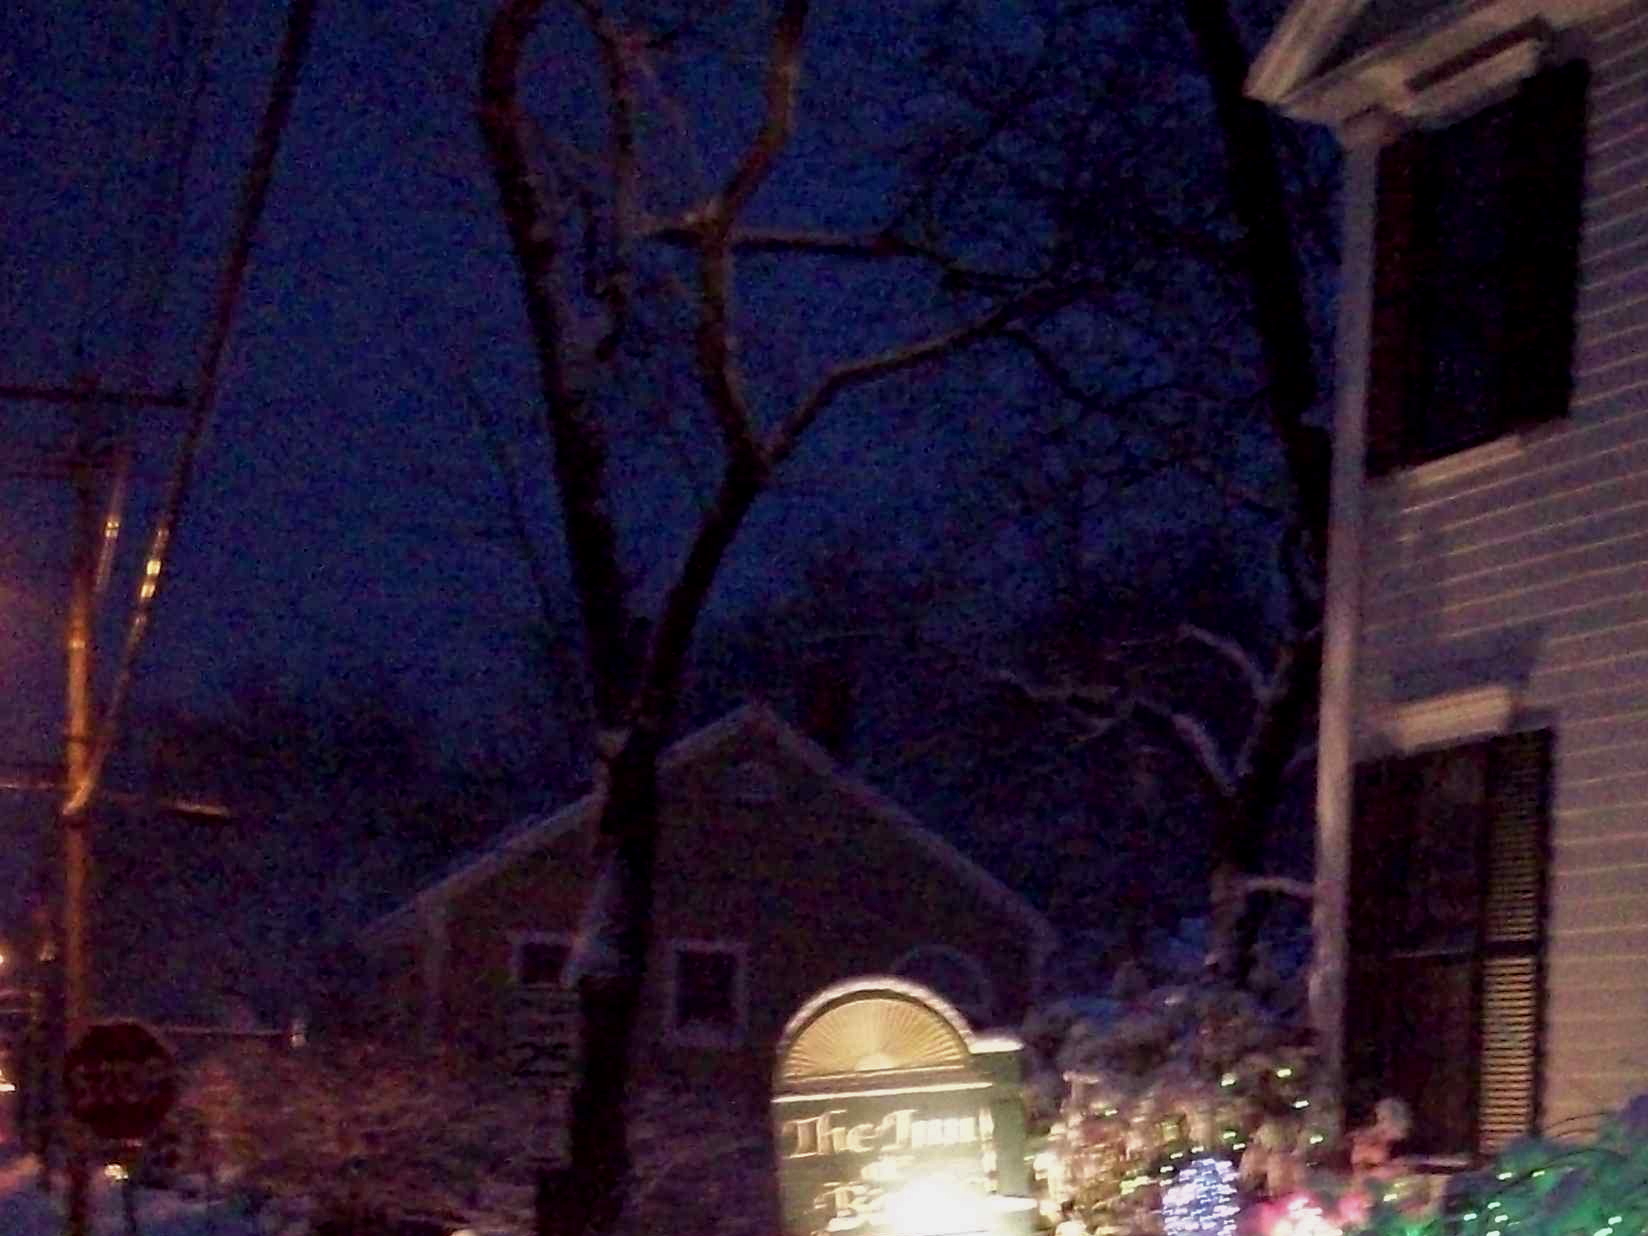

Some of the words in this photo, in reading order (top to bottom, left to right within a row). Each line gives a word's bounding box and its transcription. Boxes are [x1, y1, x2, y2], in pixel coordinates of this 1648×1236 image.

[68, 1057, 167, 1109] STOP
[779, 1109, 874, 1160] The
[874, 1108, 978, 1152] Inn
